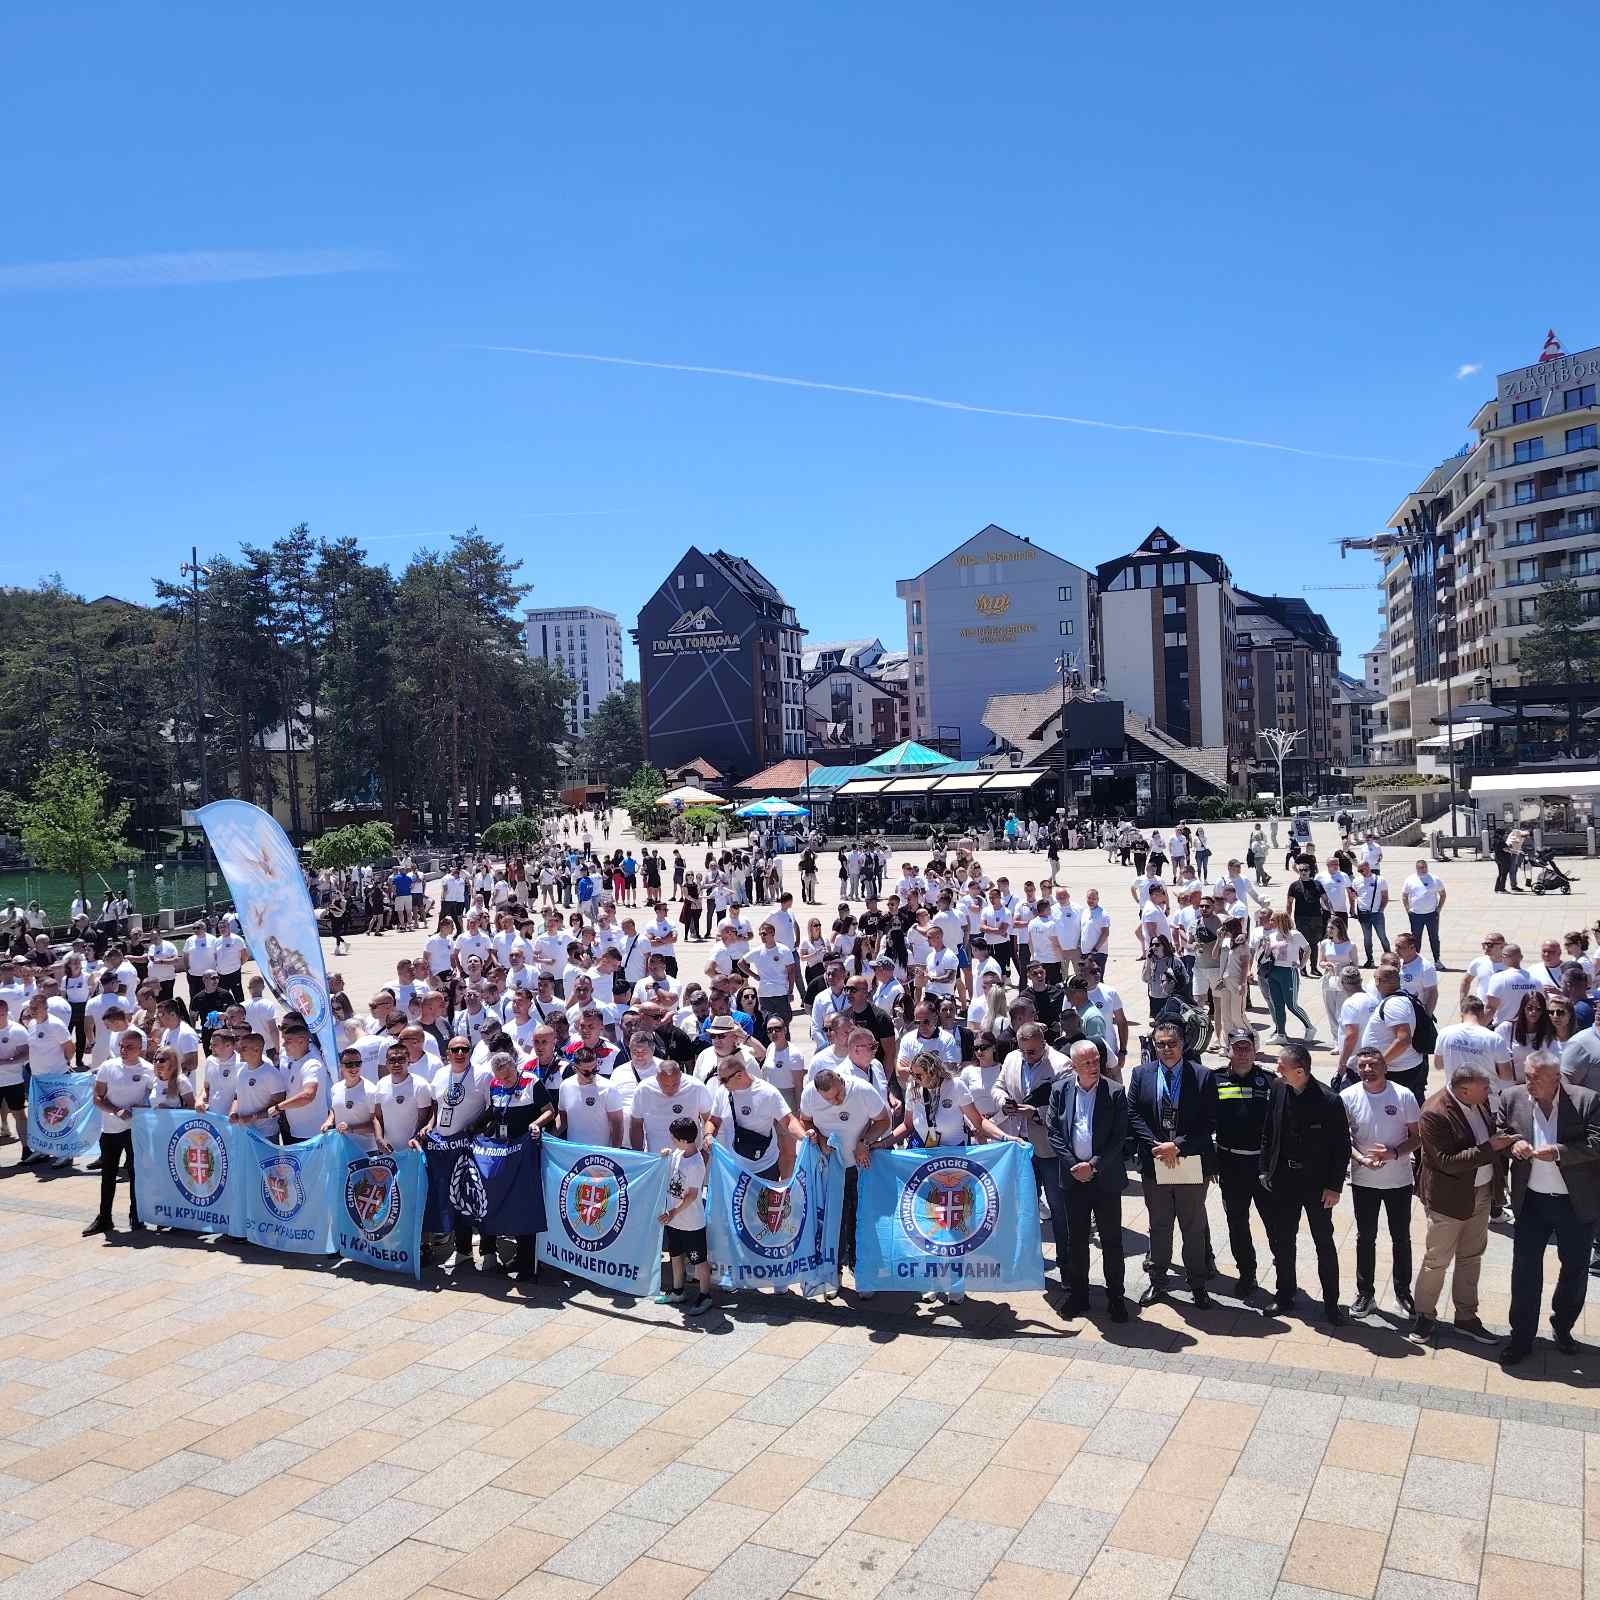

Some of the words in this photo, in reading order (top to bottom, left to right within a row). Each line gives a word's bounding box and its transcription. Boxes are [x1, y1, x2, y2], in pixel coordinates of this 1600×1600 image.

[1525, 356, 1577, 378] HOTEL
[1503, 360, 1600, 398] ZLATIBOR
[184, 1120, 211, 1131] СРПСКЕ
[190, 1195, 211, 1206] 2007
[559, 1166, 579, 1219] СИНДИКАТ
[585, 1156, 614, 1170] СРПСКЕ
[614, 1175, 628, 1233] ПОЛИЦИЈЕ
[733, 1174, 750, 1232] СИНДИКА
[902, 1175, 921, 1231] СИНДИКАТ
[927, 1159, 969, 1172] СРПСКЕ
[979, 1172, 997, 1232] ПОЛИЦИЈЕ
[574, 1236, 599, 1250] 2007
[764, 1244, 796, 1257] 2007
[931, 1244, 966, 1256] 2007
[546, 1241, 560, 1261] РЦ
[561, 1247, 640, 1281] ПРИЈЕПОЉЕ
[897, 1262, 920, 1279] СГ
[923, 1262, 1001, 1279] ЛУЧАНИ
